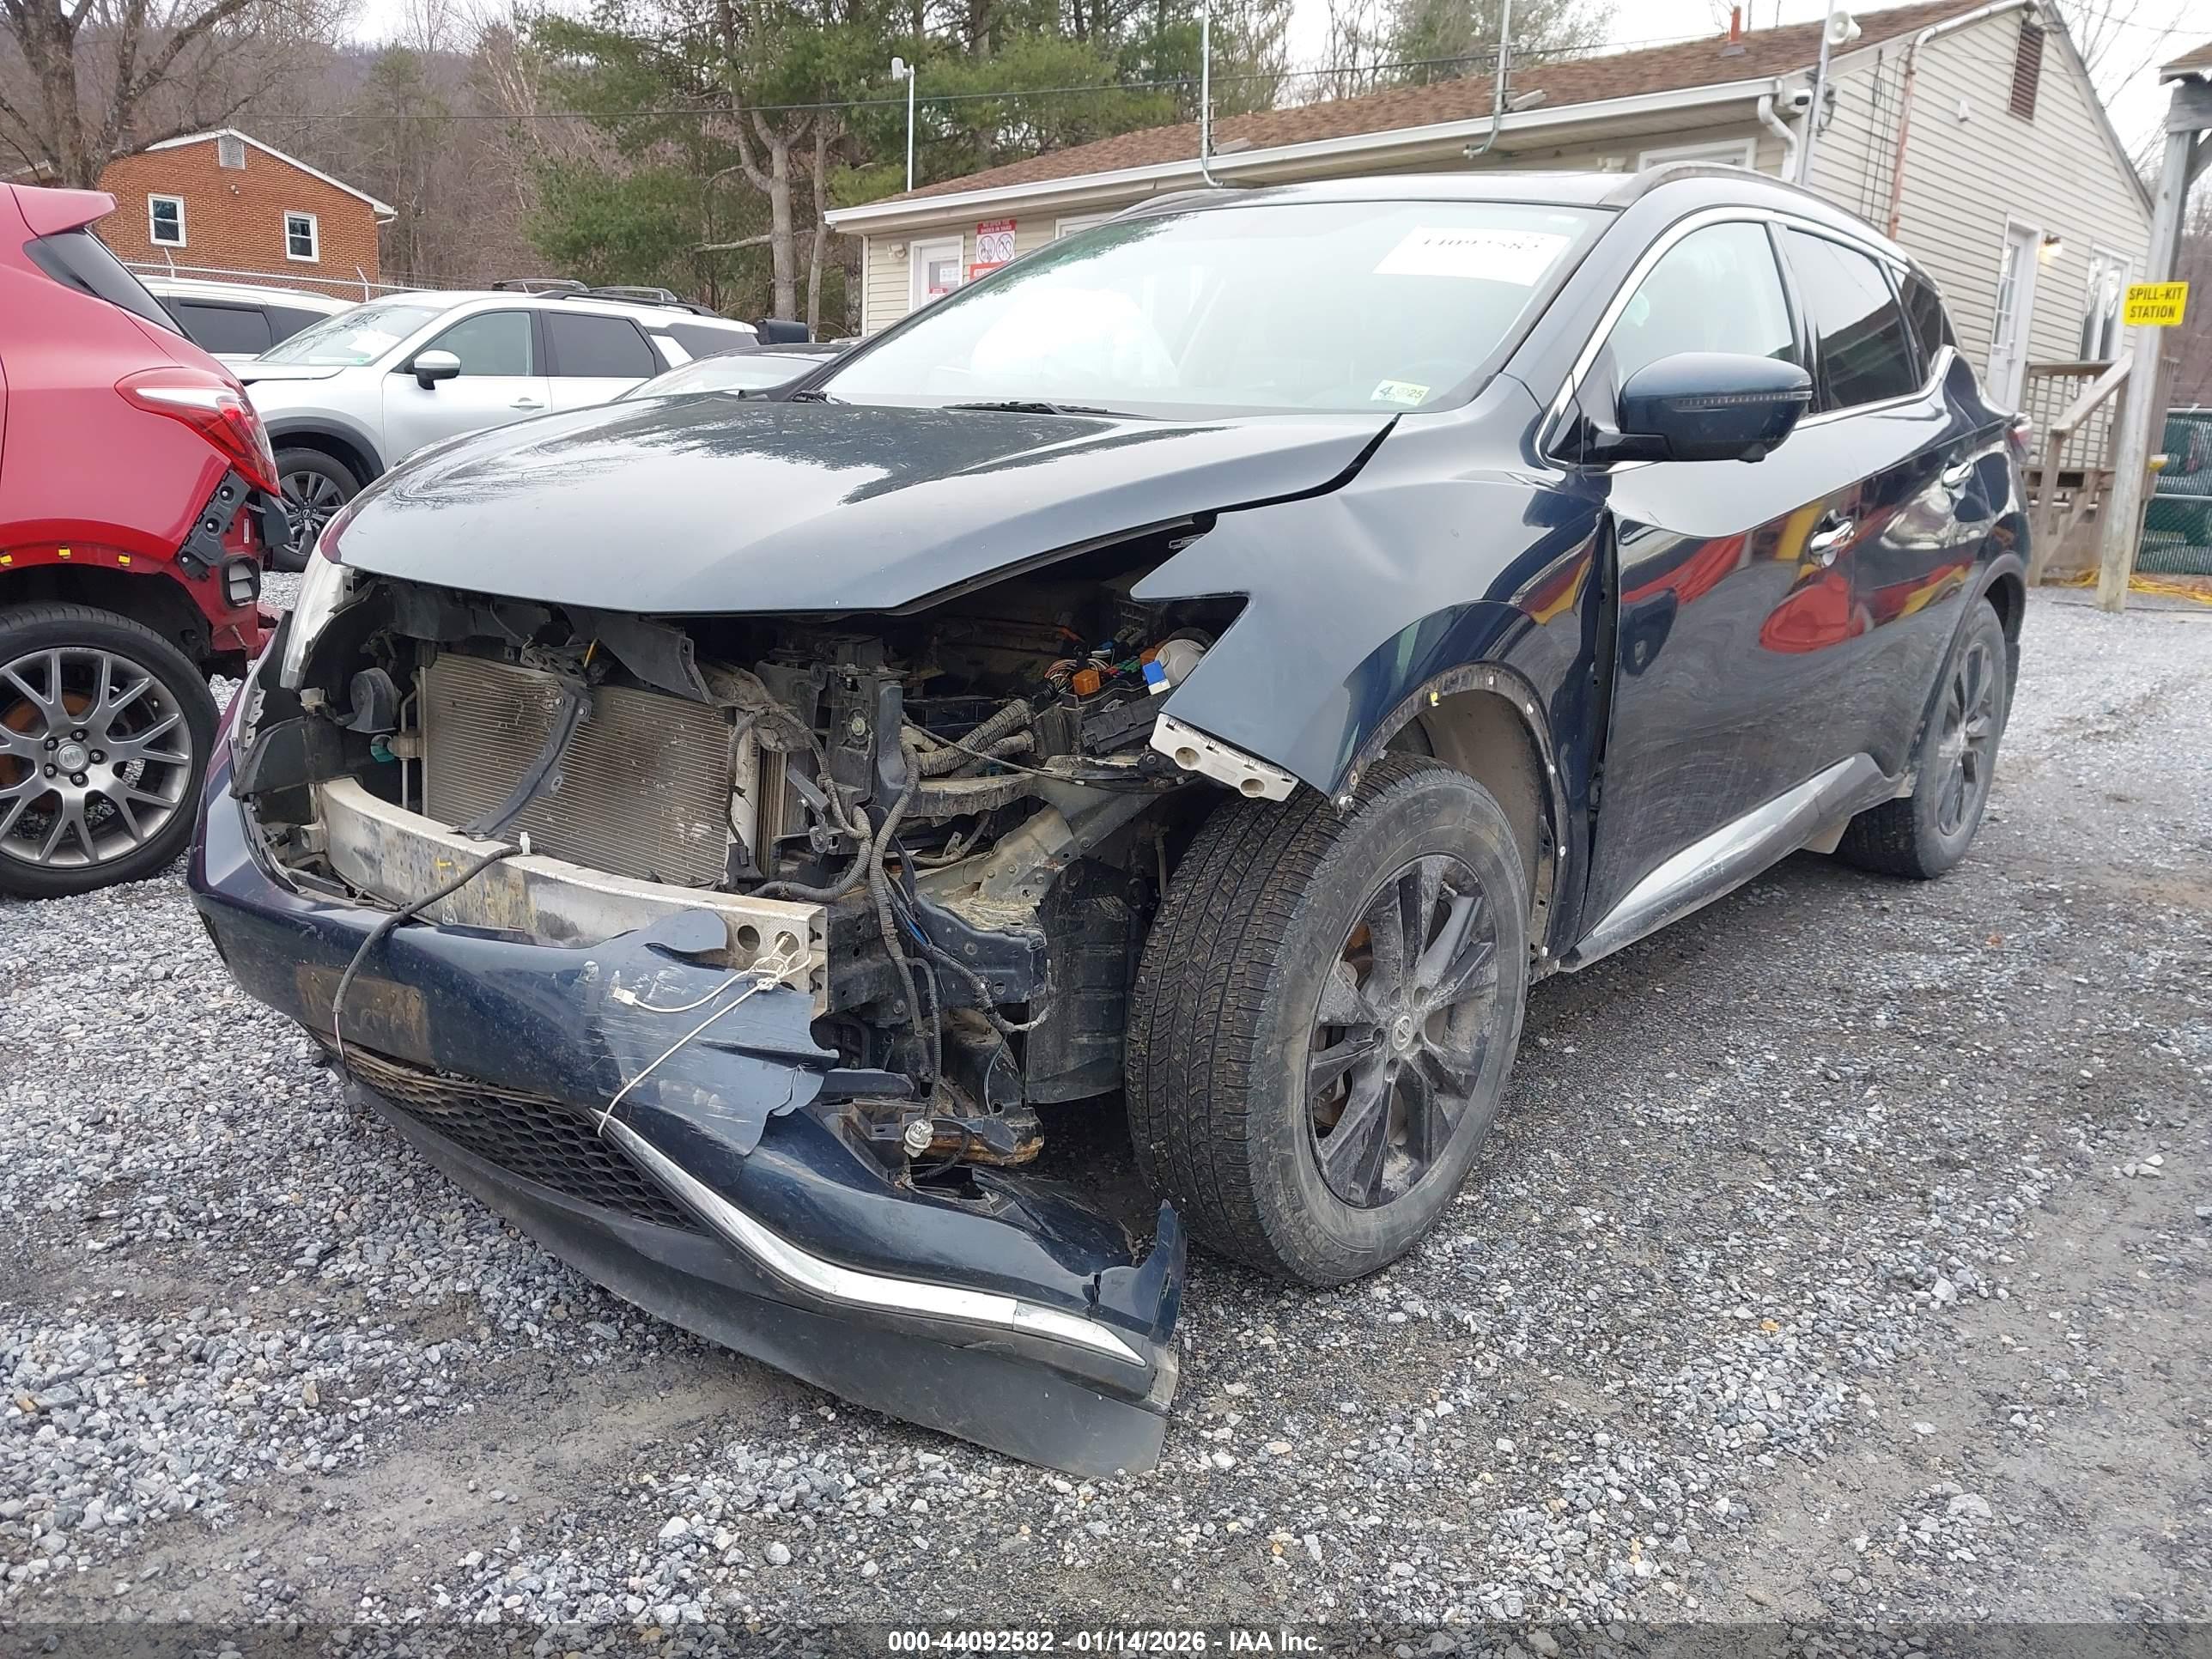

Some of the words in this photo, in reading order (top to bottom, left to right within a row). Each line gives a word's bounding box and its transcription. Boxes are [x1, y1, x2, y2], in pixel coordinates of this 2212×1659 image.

[2129, 287, 2185, 301] SPILL-KIT
[2129, 305, 2176, 318] STATION
[1408, 389, 1425, 399] 25
